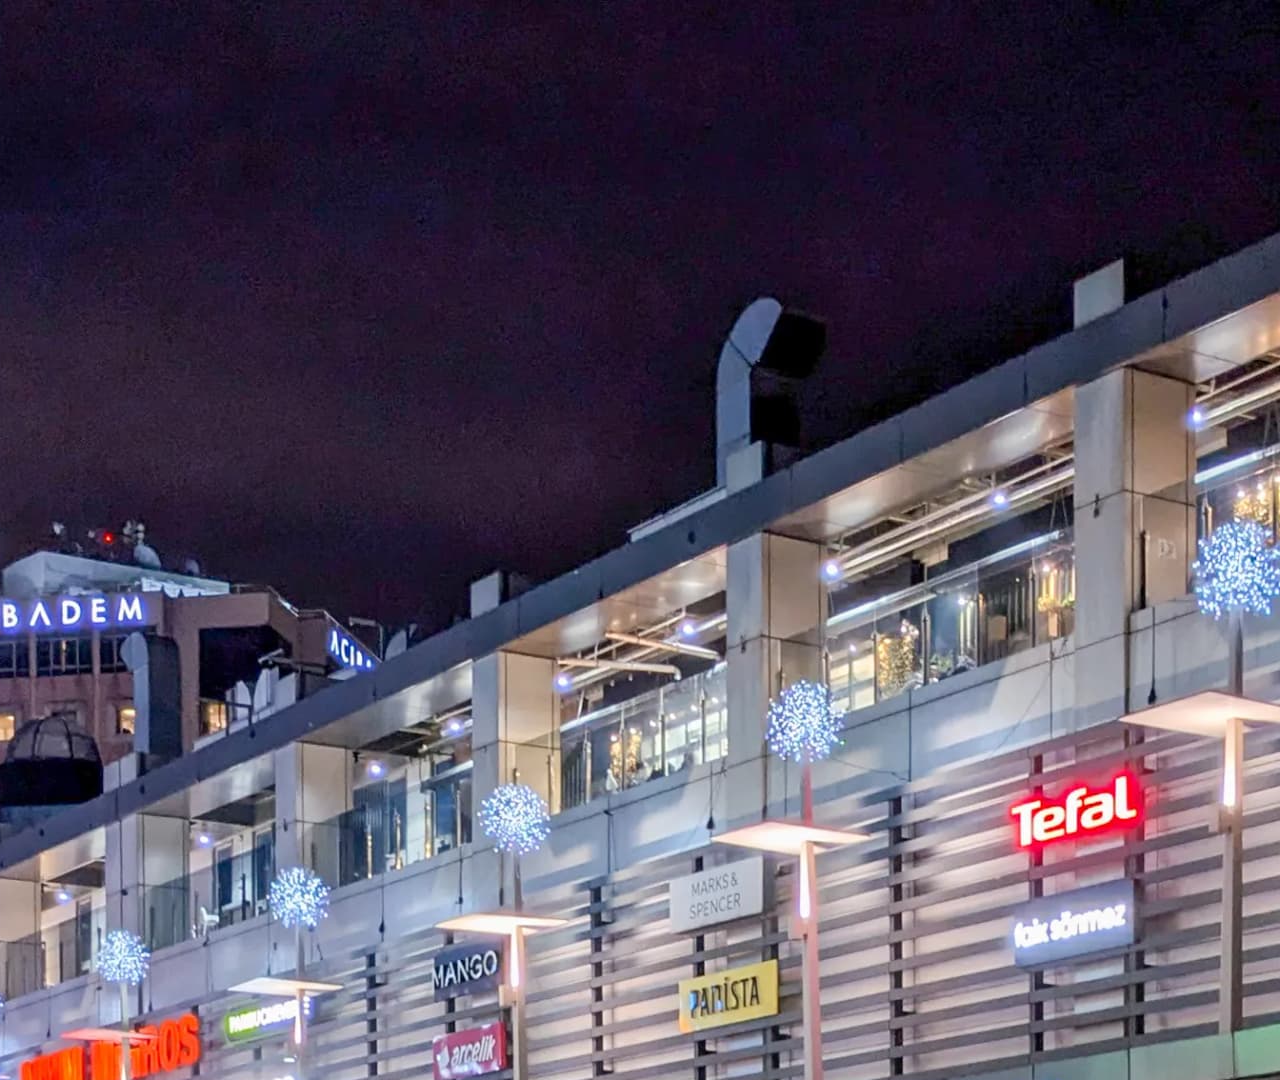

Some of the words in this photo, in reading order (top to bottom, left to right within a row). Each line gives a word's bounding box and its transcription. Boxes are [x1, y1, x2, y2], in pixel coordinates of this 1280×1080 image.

[1011, 776, 1137, 847] Tefal
[691, 876, 729, 897] MARKS
[690, 893, 741, 920] SPENCER
[431, 950, 497, 988] MANGO
